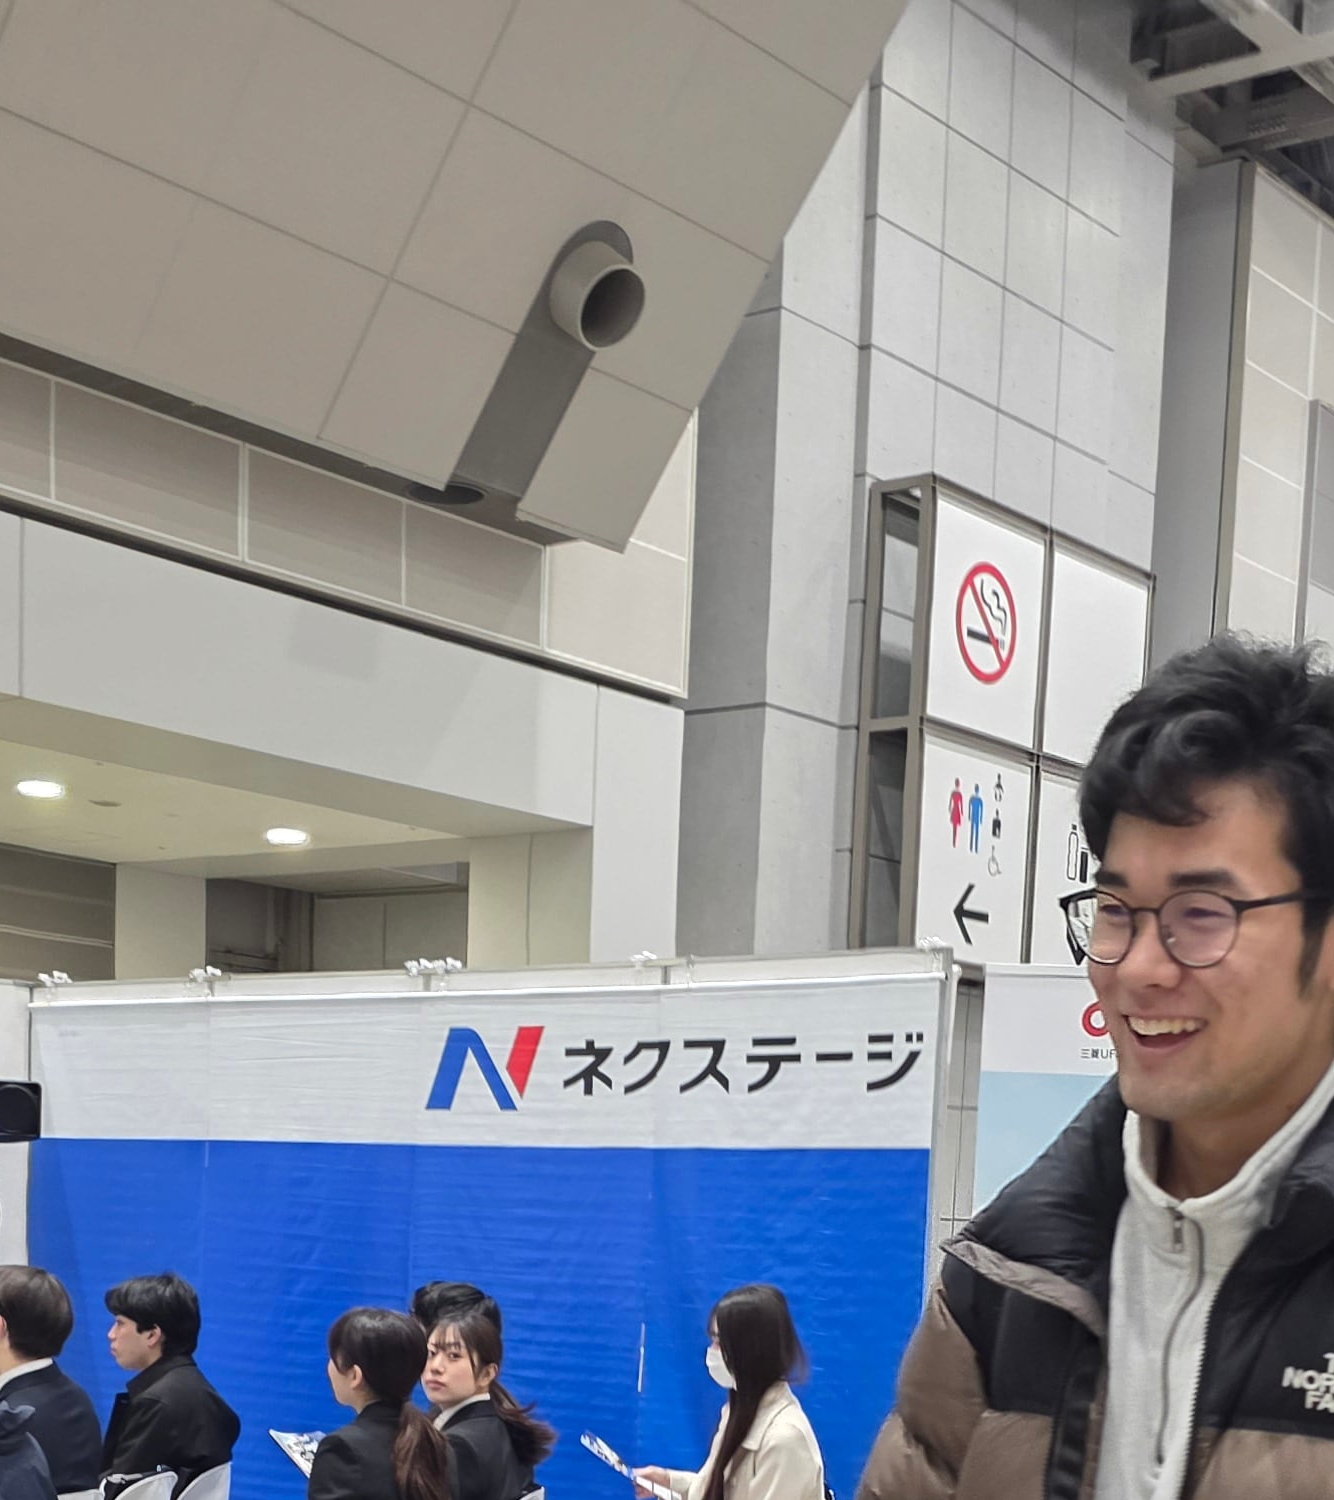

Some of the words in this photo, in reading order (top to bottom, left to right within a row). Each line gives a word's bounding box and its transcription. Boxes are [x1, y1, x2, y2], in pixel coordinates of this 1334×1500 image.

[563, 1031, 924, 1096] ネクステージ
